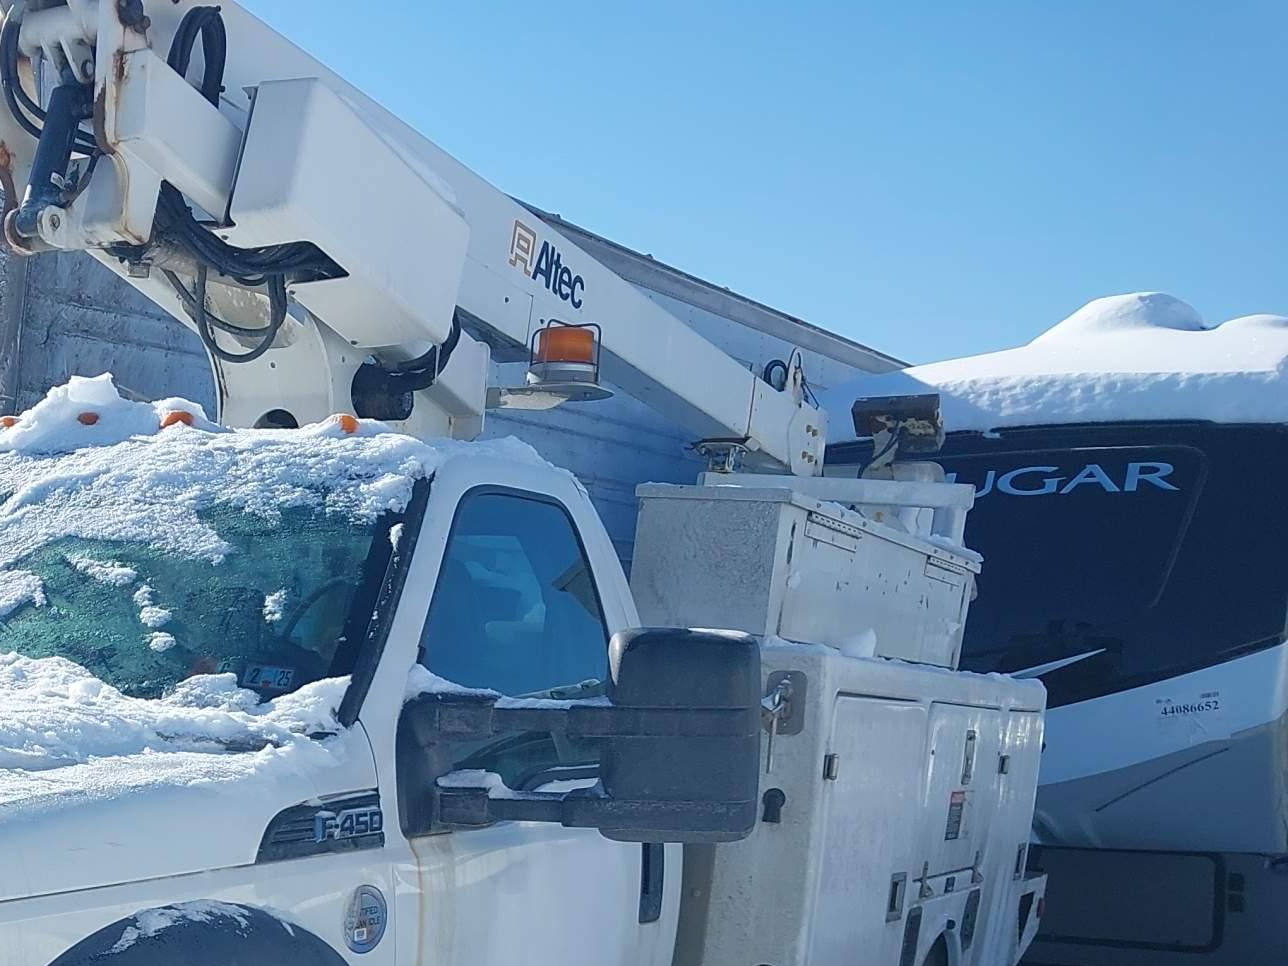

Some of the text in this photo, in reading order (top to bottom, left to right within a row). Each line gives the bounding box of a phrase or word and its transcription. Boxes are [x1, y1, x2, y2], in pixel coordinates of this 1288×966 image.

[532, 240, 585, 309] Altec
[945, 461, 1180, 498] UGAR
[1161, 700, 1220, 716] 44086652
[314, 806, 383, 842] F-450
